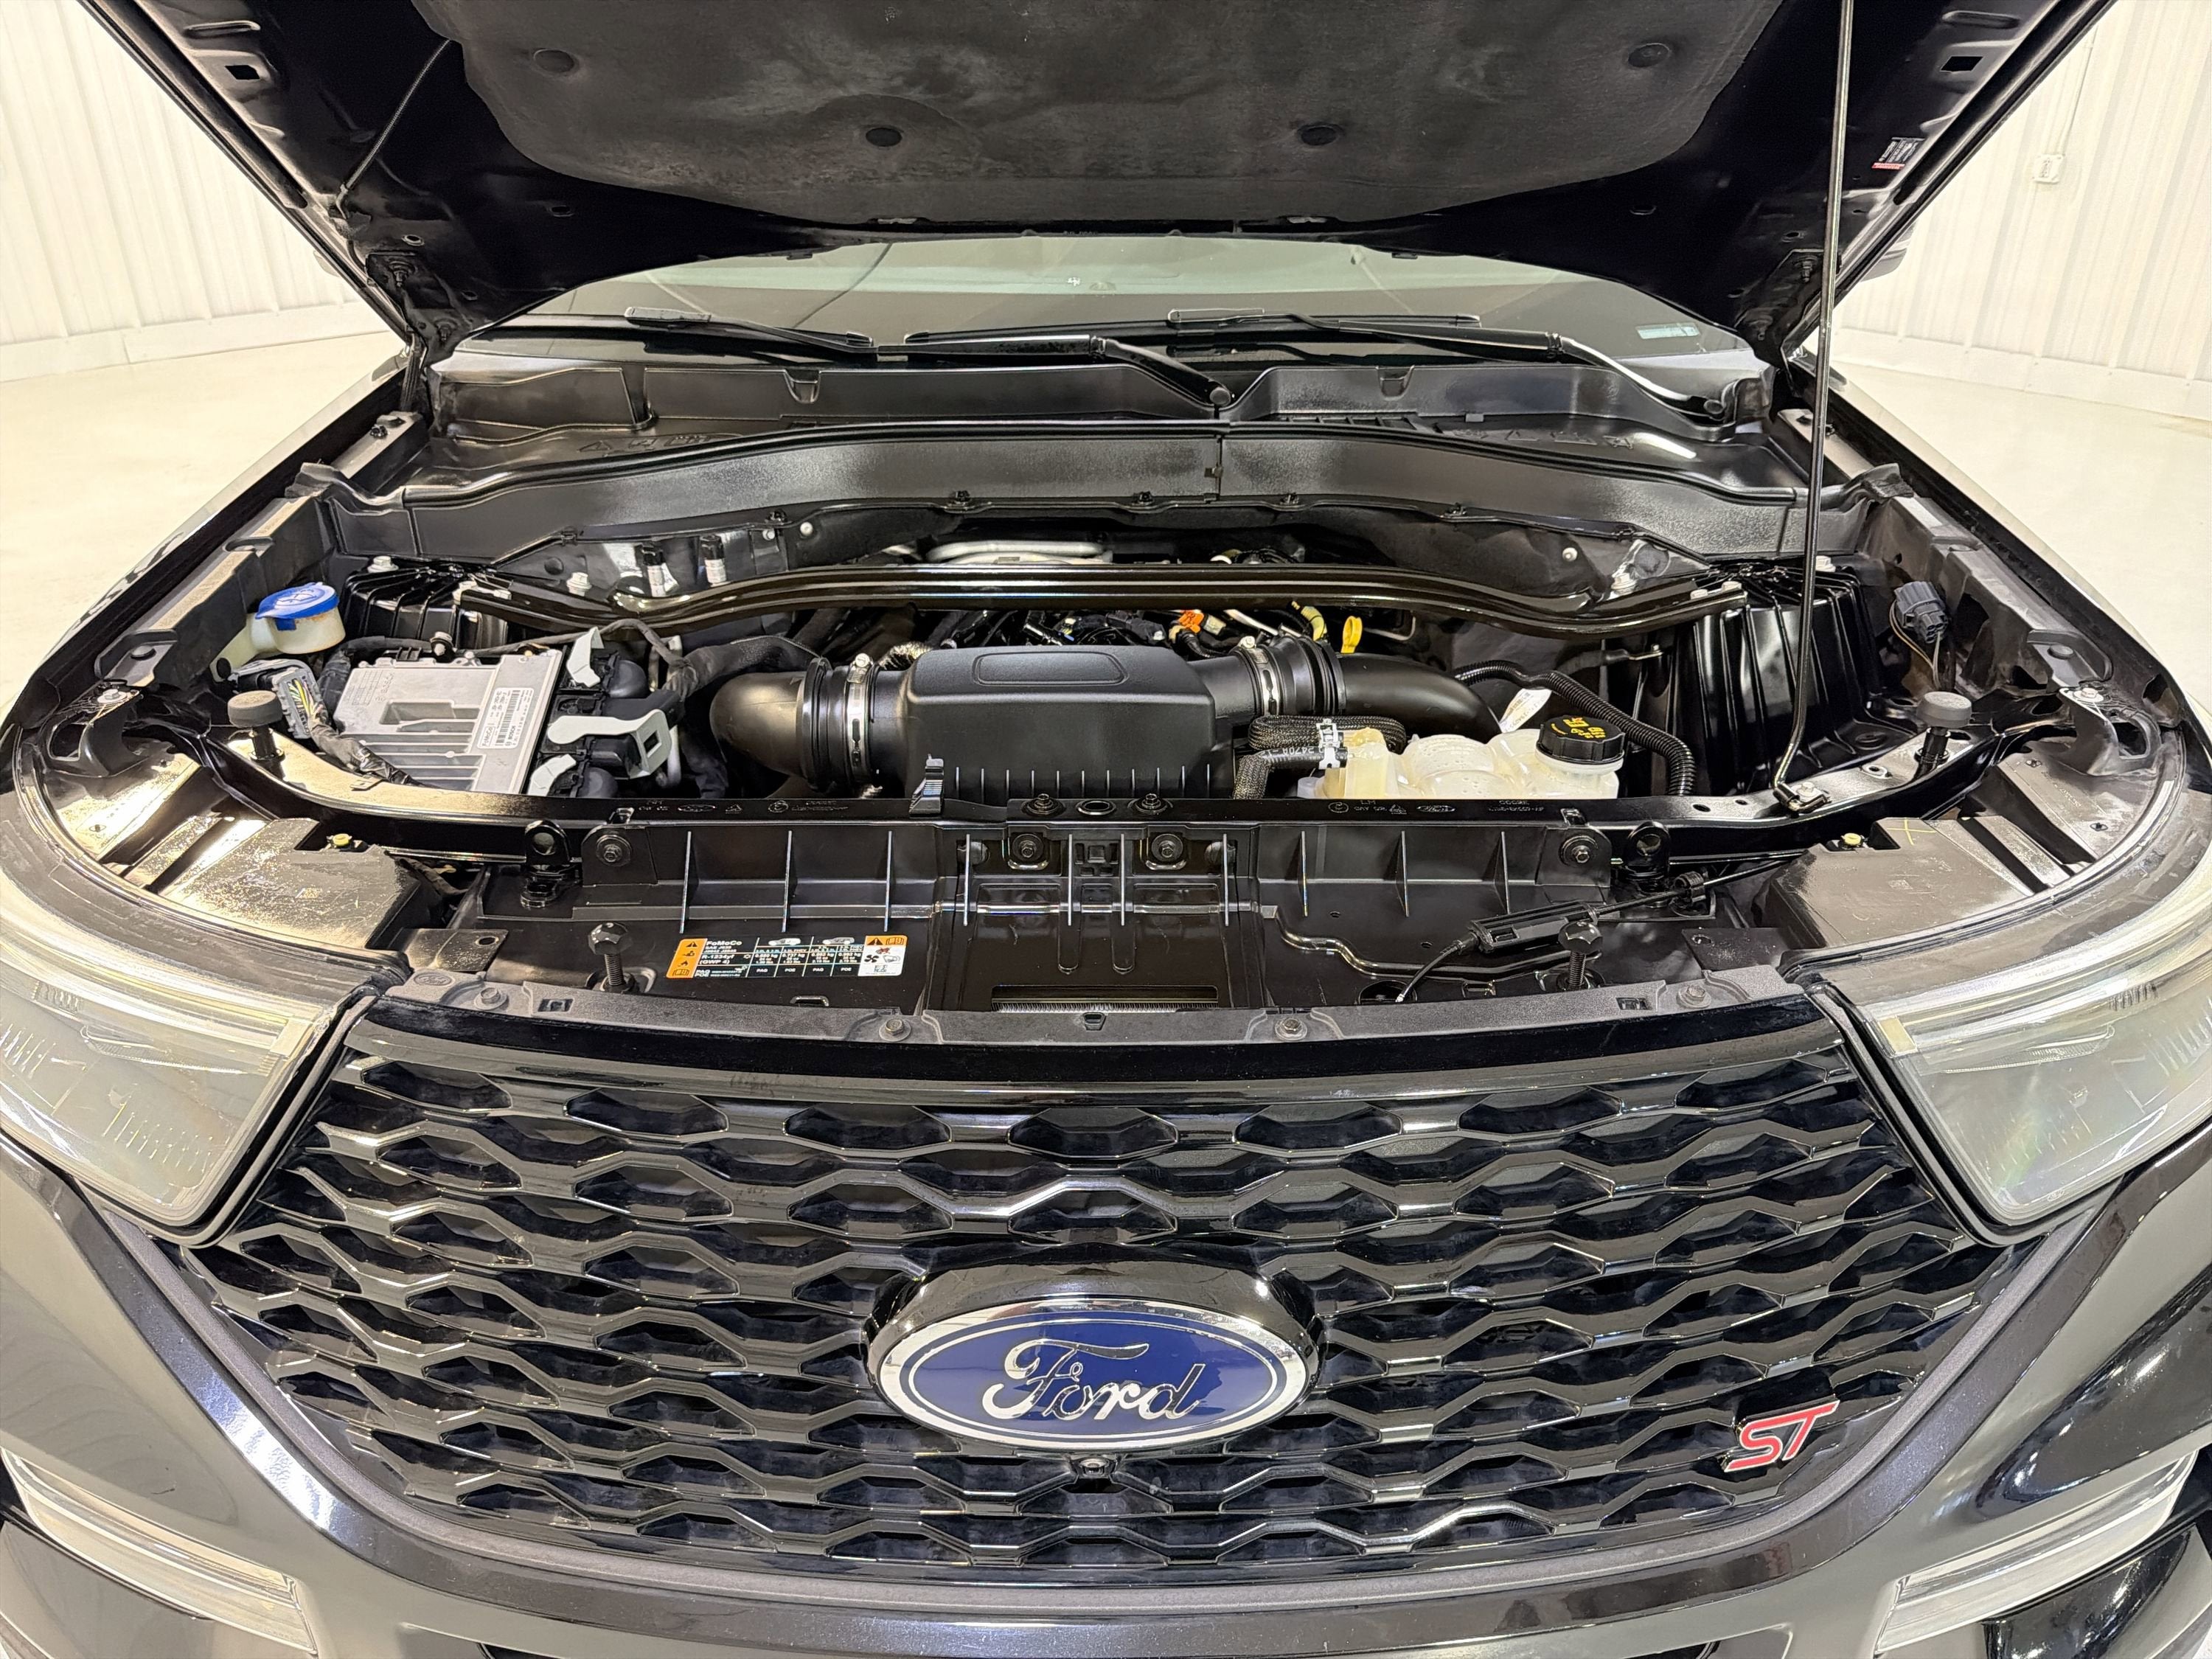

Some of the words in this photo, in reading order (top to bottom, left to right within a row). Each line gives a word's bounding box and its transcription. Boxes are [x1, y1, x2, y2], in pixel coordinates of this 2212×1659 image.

[1281, 746, 1315, 755] 2470A
[982, 1338, 1206, 1421] Ford
[1724, 1399, 1840, 1473] ST
